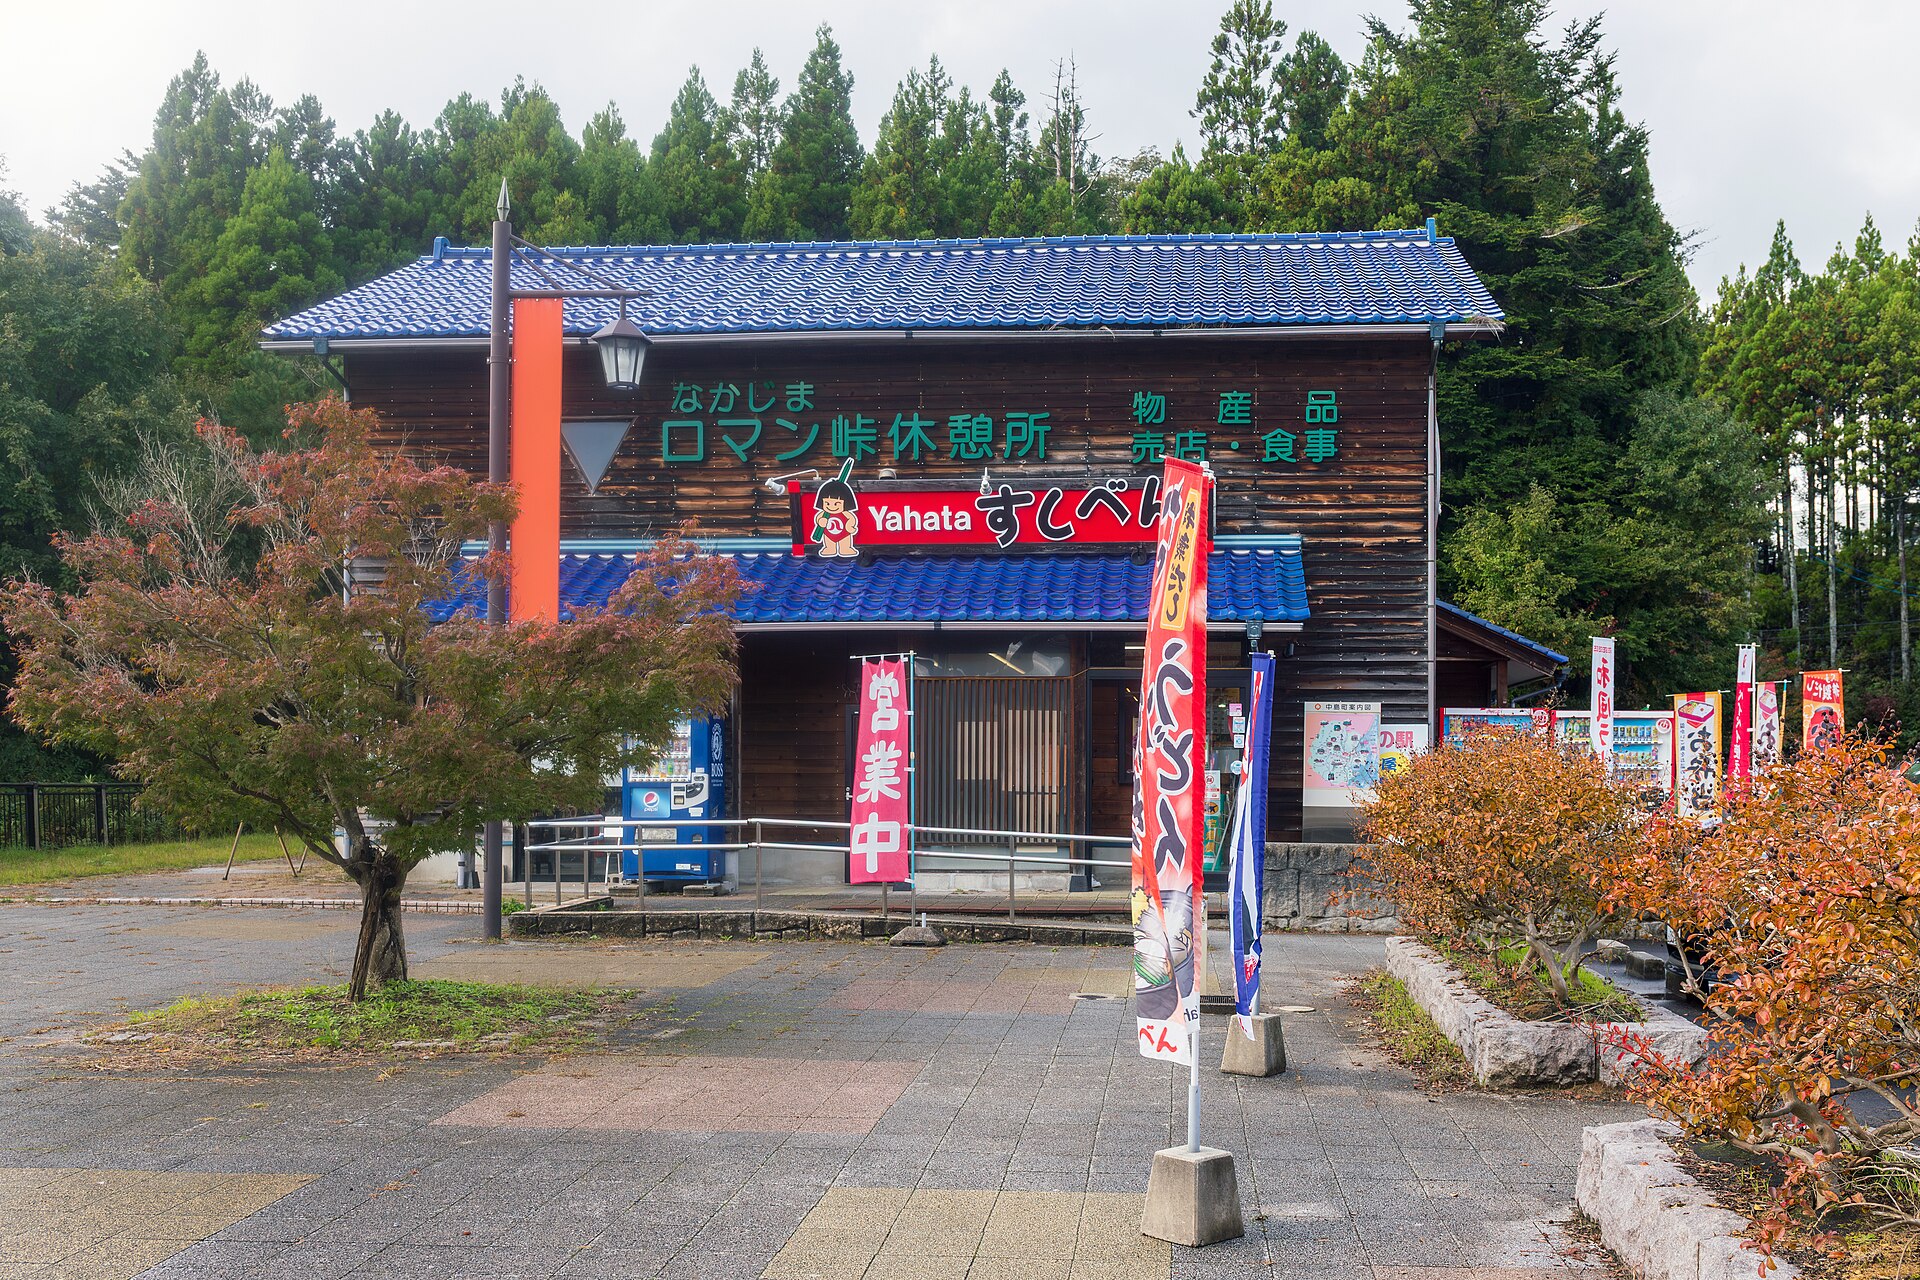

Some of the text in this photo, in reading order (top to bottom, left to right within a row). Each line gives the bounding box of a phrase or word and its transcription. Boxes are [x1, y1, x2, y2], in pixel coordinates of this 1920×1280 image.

[671, 381, 815, 413] なかじま
[1133, 391, 1338, 424] 物産品
[662, 412, 1052, 462] ロマン峠休憩所
[868, 505, 972, 532] Yahata
[711, 763, 724, 777] BOSS
[851, 668, 902, 874] 営業中
